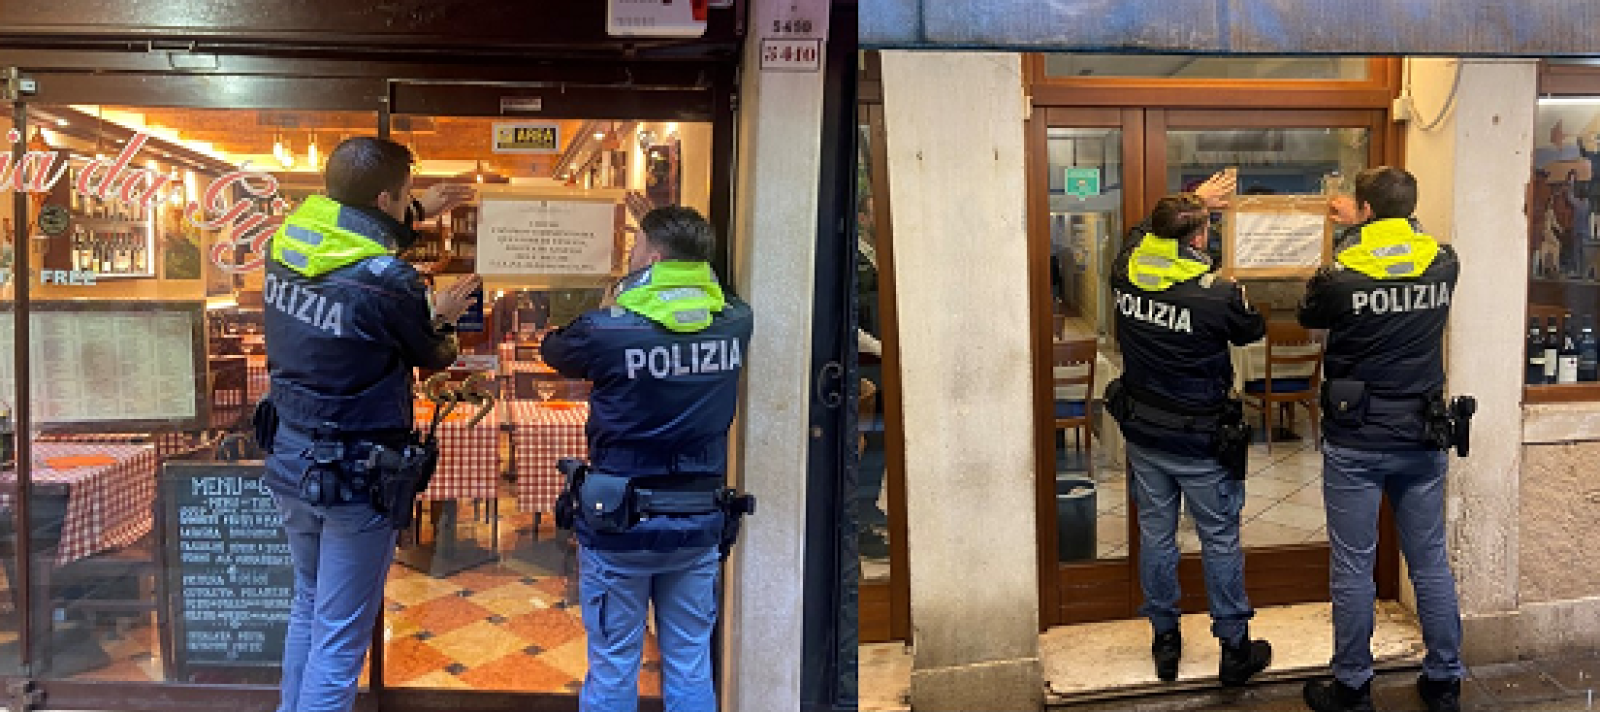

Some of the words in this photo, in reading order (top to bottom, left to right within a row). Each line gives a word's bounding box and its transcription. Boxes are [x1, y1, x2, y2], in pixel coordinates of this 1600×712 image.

[76, 132, 181, 207] da
[40, 269, 97, 286] FREE
[1352, 281, 1451, 315] POLIZIA
[264, 273, 344, 337] OLIZIA
[625, 339, 741, 380] POLIZIA
